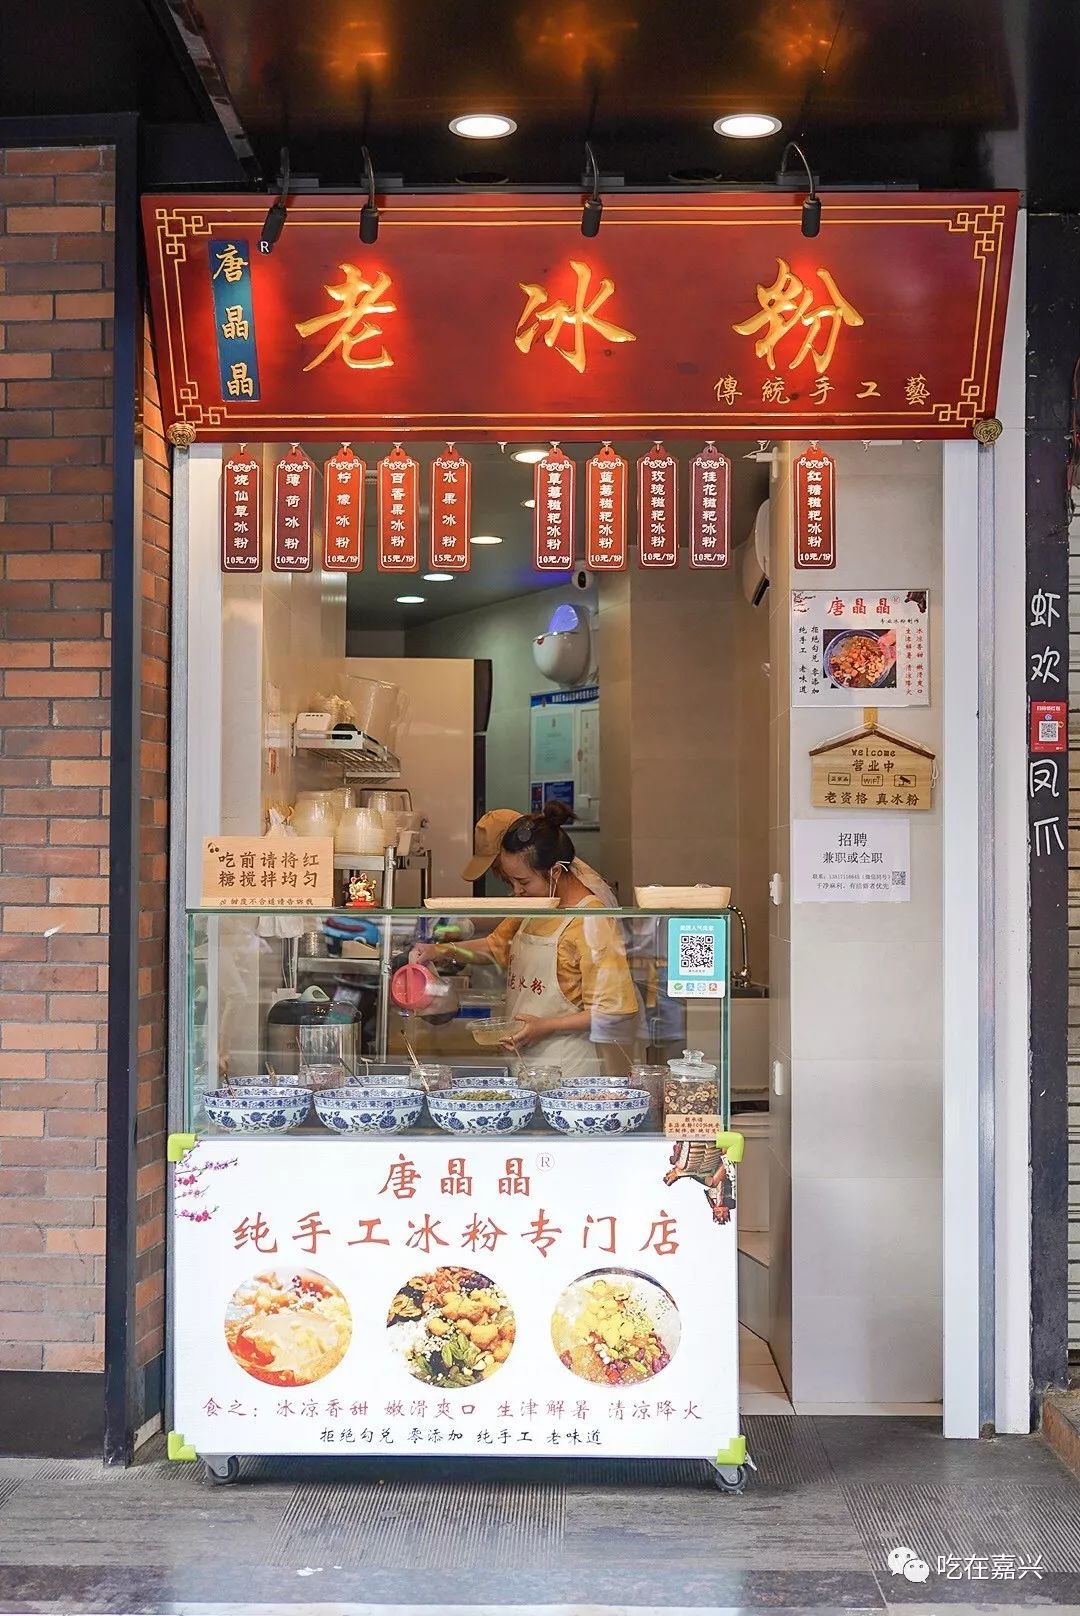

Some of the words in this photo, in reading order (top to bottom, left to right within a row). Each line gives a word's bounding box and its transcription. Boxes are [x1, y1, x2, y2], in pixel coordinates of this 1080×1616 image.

[213, 245, 255, 398] 唐晶晶
[295, 258, 865, 374] 老冰粉
[714, 376, 931, 405] 傳統手工藝
[234, 474, 249, 549] 烧仙草冰粉
[285, 473, 300, 549] 薄荷冰粉
[335, 471, 352, 548] 柠檬冰粉
[390, 472, 406, 547] 百香果冰粉
[442, 471, 457, 547] 水果冰粉
[547, 472, 562, 550] 草莓糍粑冰粉
[650, 470, 666, 548] 玫瑰糍粑冰粉
[702, 471, 718, 548] 桂花糍粑冰粉
[807, 470, 822, 548] 红糖糍粑冰粉
[226, 556, 258, 564] 10元/份
[276, 556, 308, 564] 10元/份
[327, 555, 358, 563] 10元/份
[383, 554, 415, 563] 15元/份
[434, 554, 466, 562] 15元/份
[539, 555, 570, 564] 10元/份
[591, 554, 622, 563] 10元/份
[643, 553, 675, 562] 10元/份
[694, 553, 726, 562] 10元/份
[800, 553, 832, 562] 10元/份
[827, 597, 890, 616] 唐晶晶
[799, 627, 808, 653] 纯手工
[798, 665, 808, 694] 老味道
[811, 667, 820, 694] 零添加
[851, 748, 896, 757] welcome
[852, 760, 895, 773] 营业中
[824, 791, 868, 805] 老资格
[875, 792, 919, 806] 真冰粉
[838, 832, 868, 847] 招聘
[218, 851, 319, 869] 吃前请将红
[822, 851, 883, 864] 兼职或全职
[218, 870, 318, 888] 糖搅拌均匀
[377, 1153, 531, 1199] 唐晶晶
[233, 1208, 682, 1258] 纯手工冰粉专门店
[276, 1398, 368, 1418] 冰凉香甜
[384, 1398, 476, 1419] 嫩滑爽口
[608, 1400, 703, 1421] 清凉降火
[320, 1427, 395, 1444] 拒绝勾兑
[407, 1428, 463, 1444] 零添加
[477, 1429, 533, 1445] 纯手工
[547, 1430, 603, 1445] 老味道
